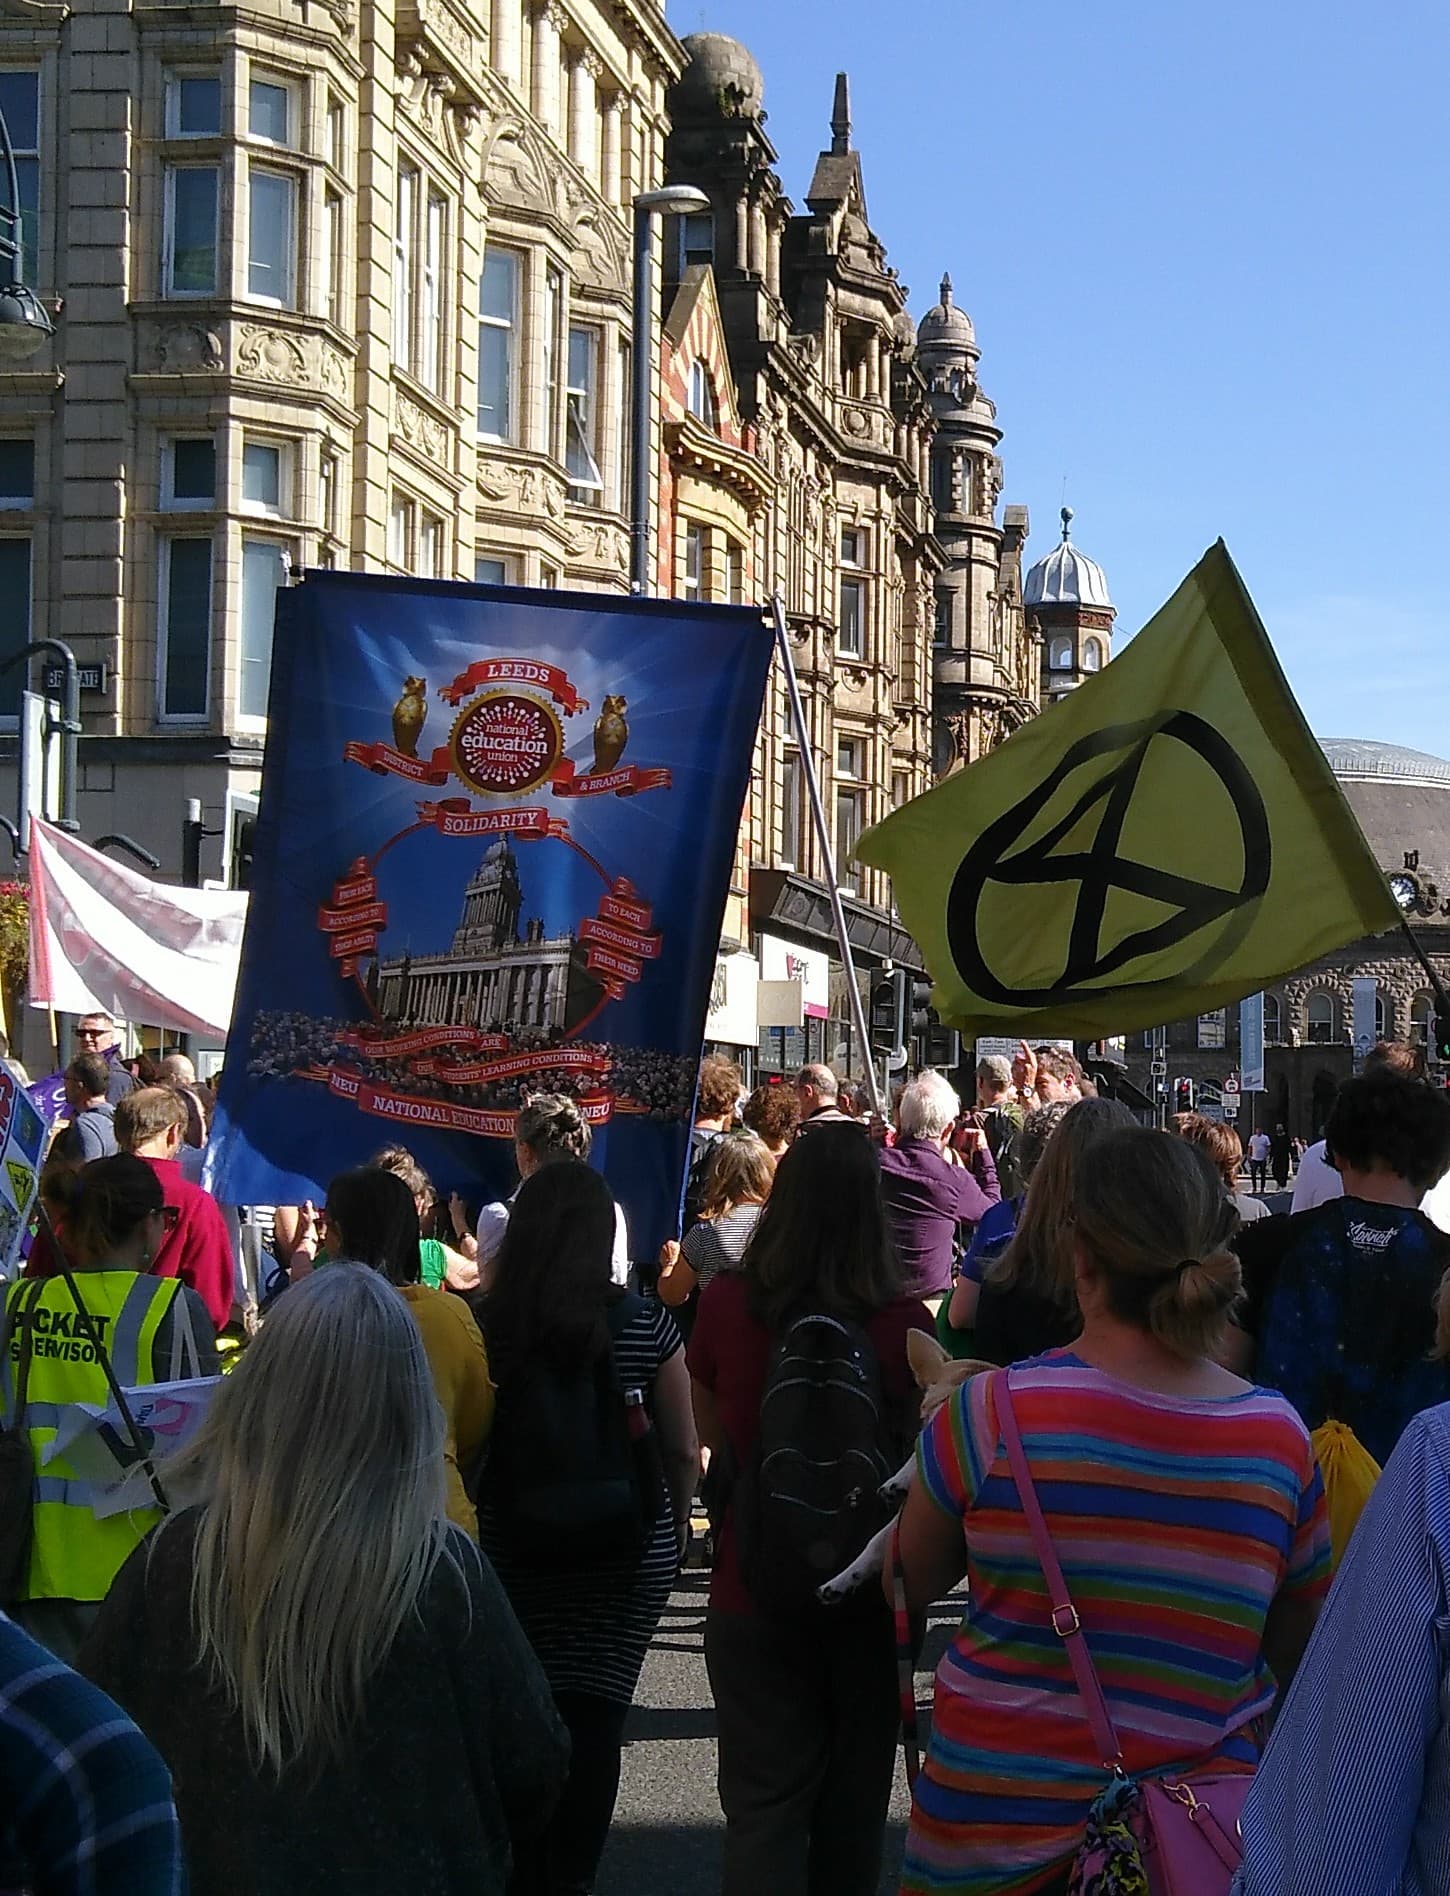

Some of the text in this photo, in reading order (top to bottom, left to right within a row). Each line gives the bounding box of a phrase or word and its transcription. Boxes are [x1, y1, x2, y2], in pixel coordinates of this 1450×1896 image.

[49, 670, 99, 687] BRATE
[487, 664, 550, 682] LEEDS
[485, 724, 529, 736] national
[461, 731, 549, 754] education
[383, 751, 424, 776] DISTRICT
[487, 751, 519, 762] union
[589, 771, 630, 790] BRANCH
[443, 812, 539, 833] SOLIDARITY
[608, 903, 641, 922] TO EACH
[590, 925, 652, 953] ACCORDING TO
[594, 952, 639, 976] THEIR NEED
[423, 1029, 475, 1045] CONDITIONS
[480, 1038, 501, 1048] ARE
[482, 1058, 530, 1076] LEARNING
[532, 1052, 593, 1067] CONDITIONS
[331, 1073, 515, 1132] NEU NATIONAL EDUCATION
[583, 1102, 611, 1118] NEU
[11, 1307, 111, 1342] PCKET
[10, 1337, 108, 1365] SERVISO
